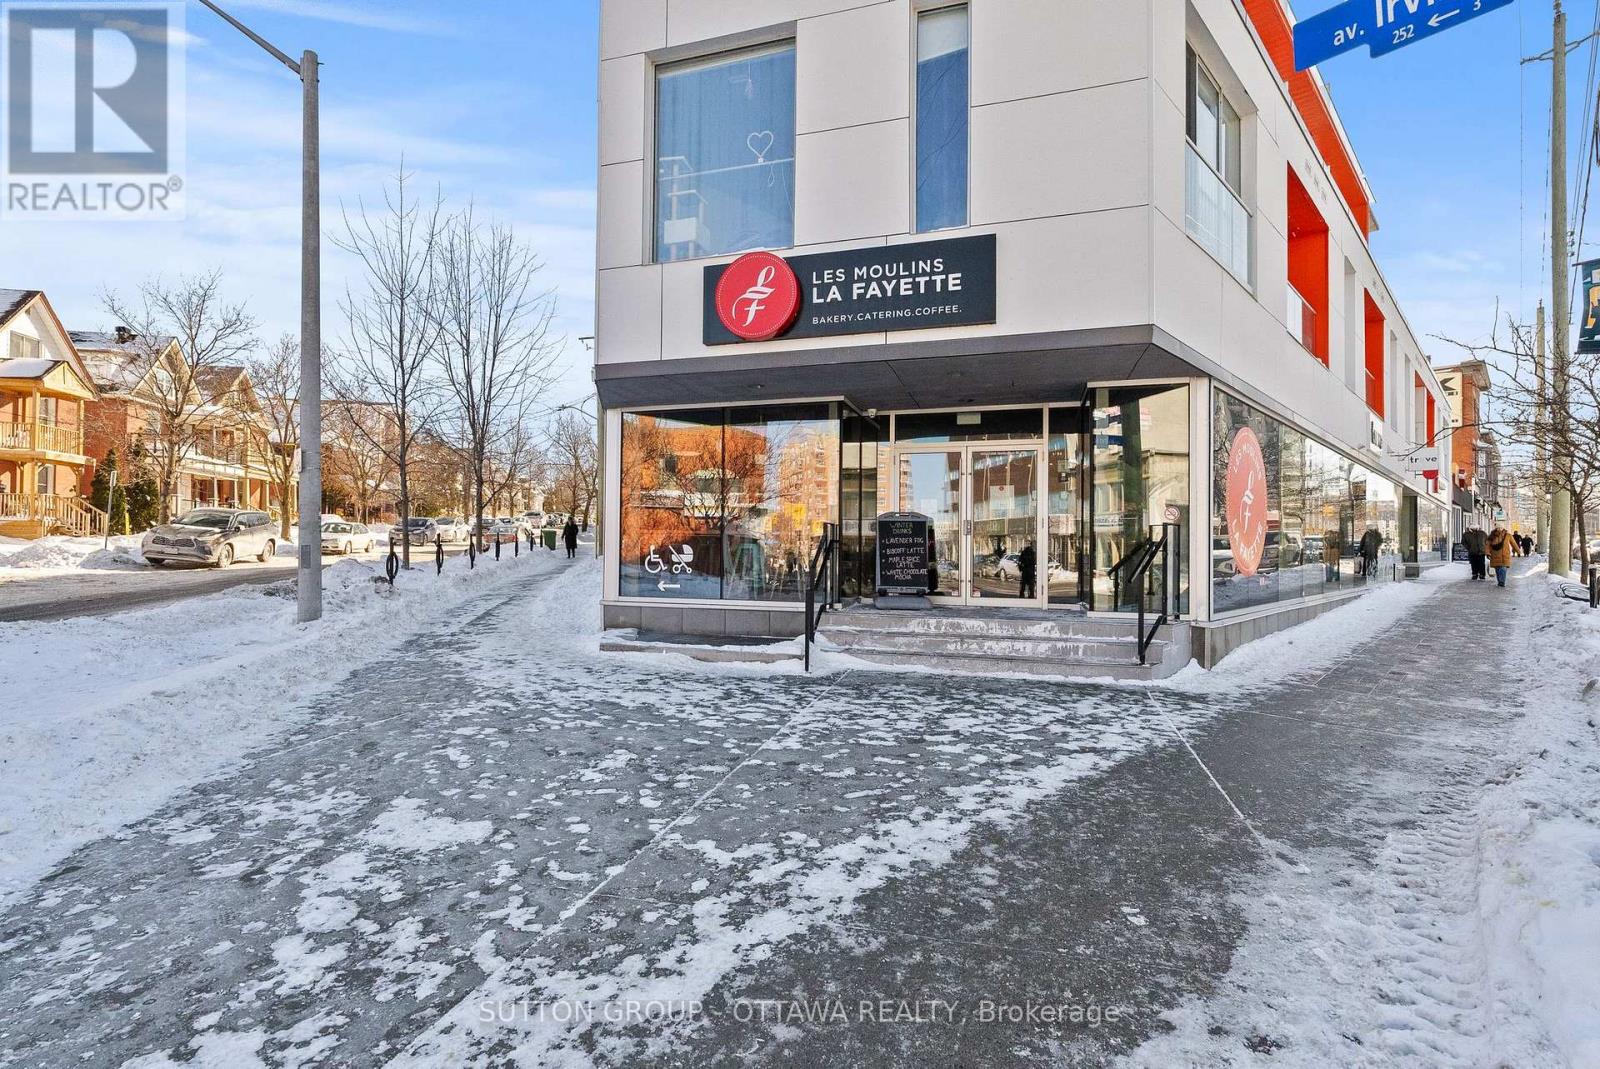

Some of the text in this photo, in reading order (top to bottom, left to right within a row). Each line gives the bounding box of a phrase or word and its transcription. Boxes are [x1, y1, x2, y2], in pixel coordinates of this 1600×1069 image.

[1333, 22, 1365, 46] av.
[1392, 24, 1415, 44] 252
[812, 258, 944, 284] LES MOULINS
[812, 273, 962, 304] LA FAYETTE
